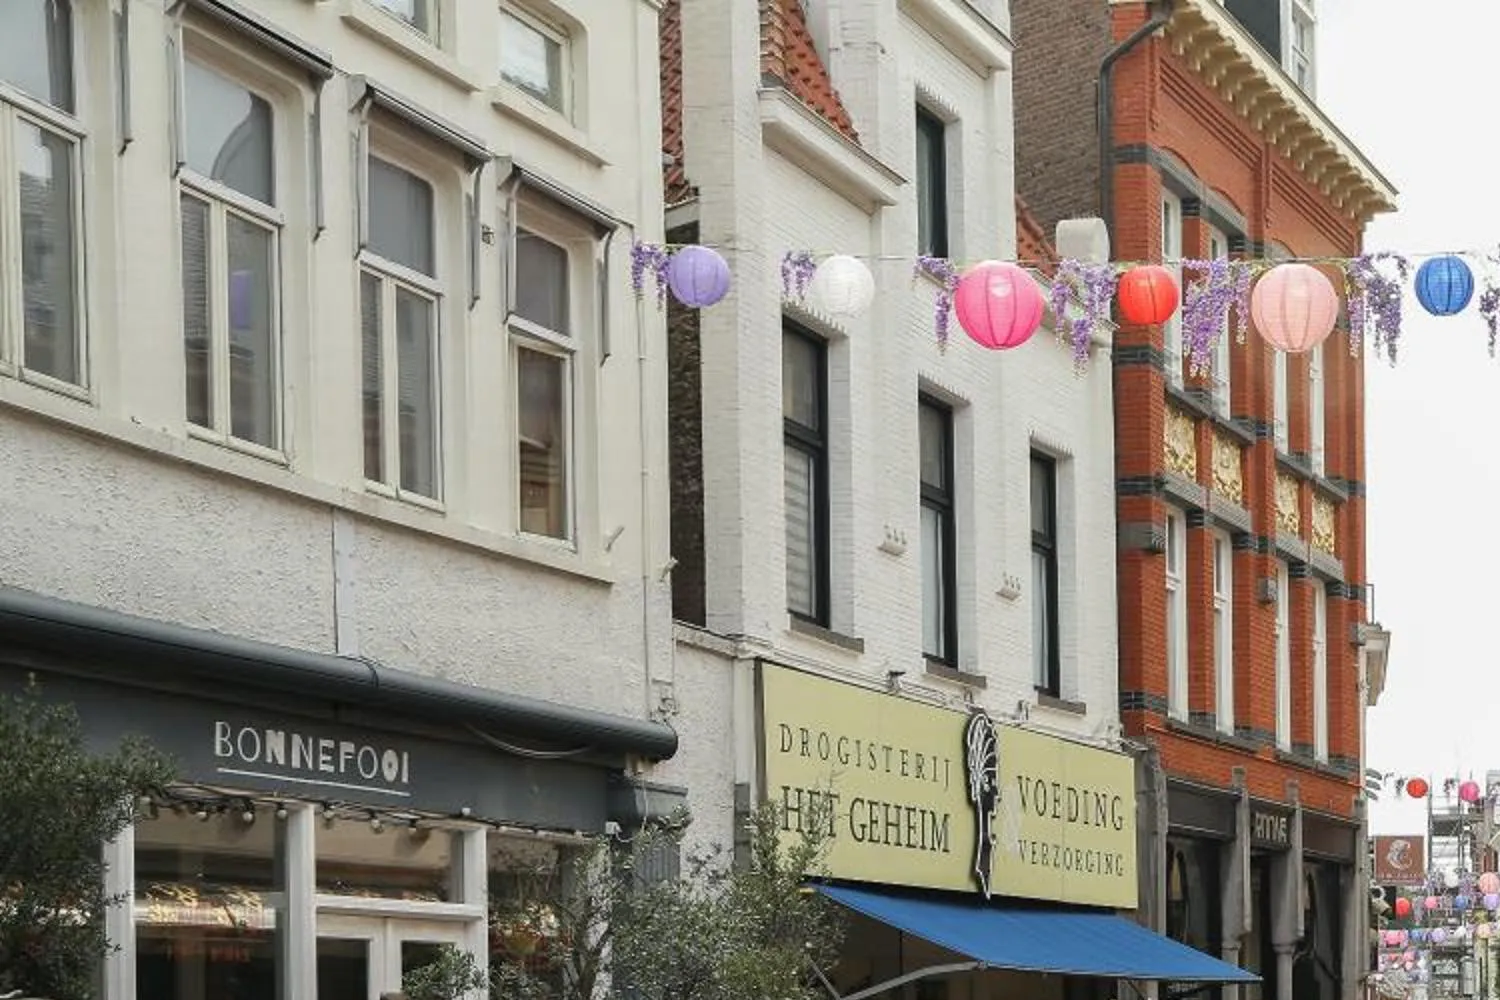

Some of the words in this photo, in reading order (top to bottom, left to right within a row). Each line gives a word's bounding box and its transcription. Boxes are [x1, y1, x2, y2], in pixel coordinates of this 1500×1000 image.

[214, 721, 409, 783] BONNEFOOI
[779, 723, 951, 792] DROGISTERIJ
[780, 785, 841, 838] HET
[849, 797, 951, 853] GEHEIM
[1017, 775, 1123, 831] VOEDING
[1017, 839, 1124, 877] VERZORGING
